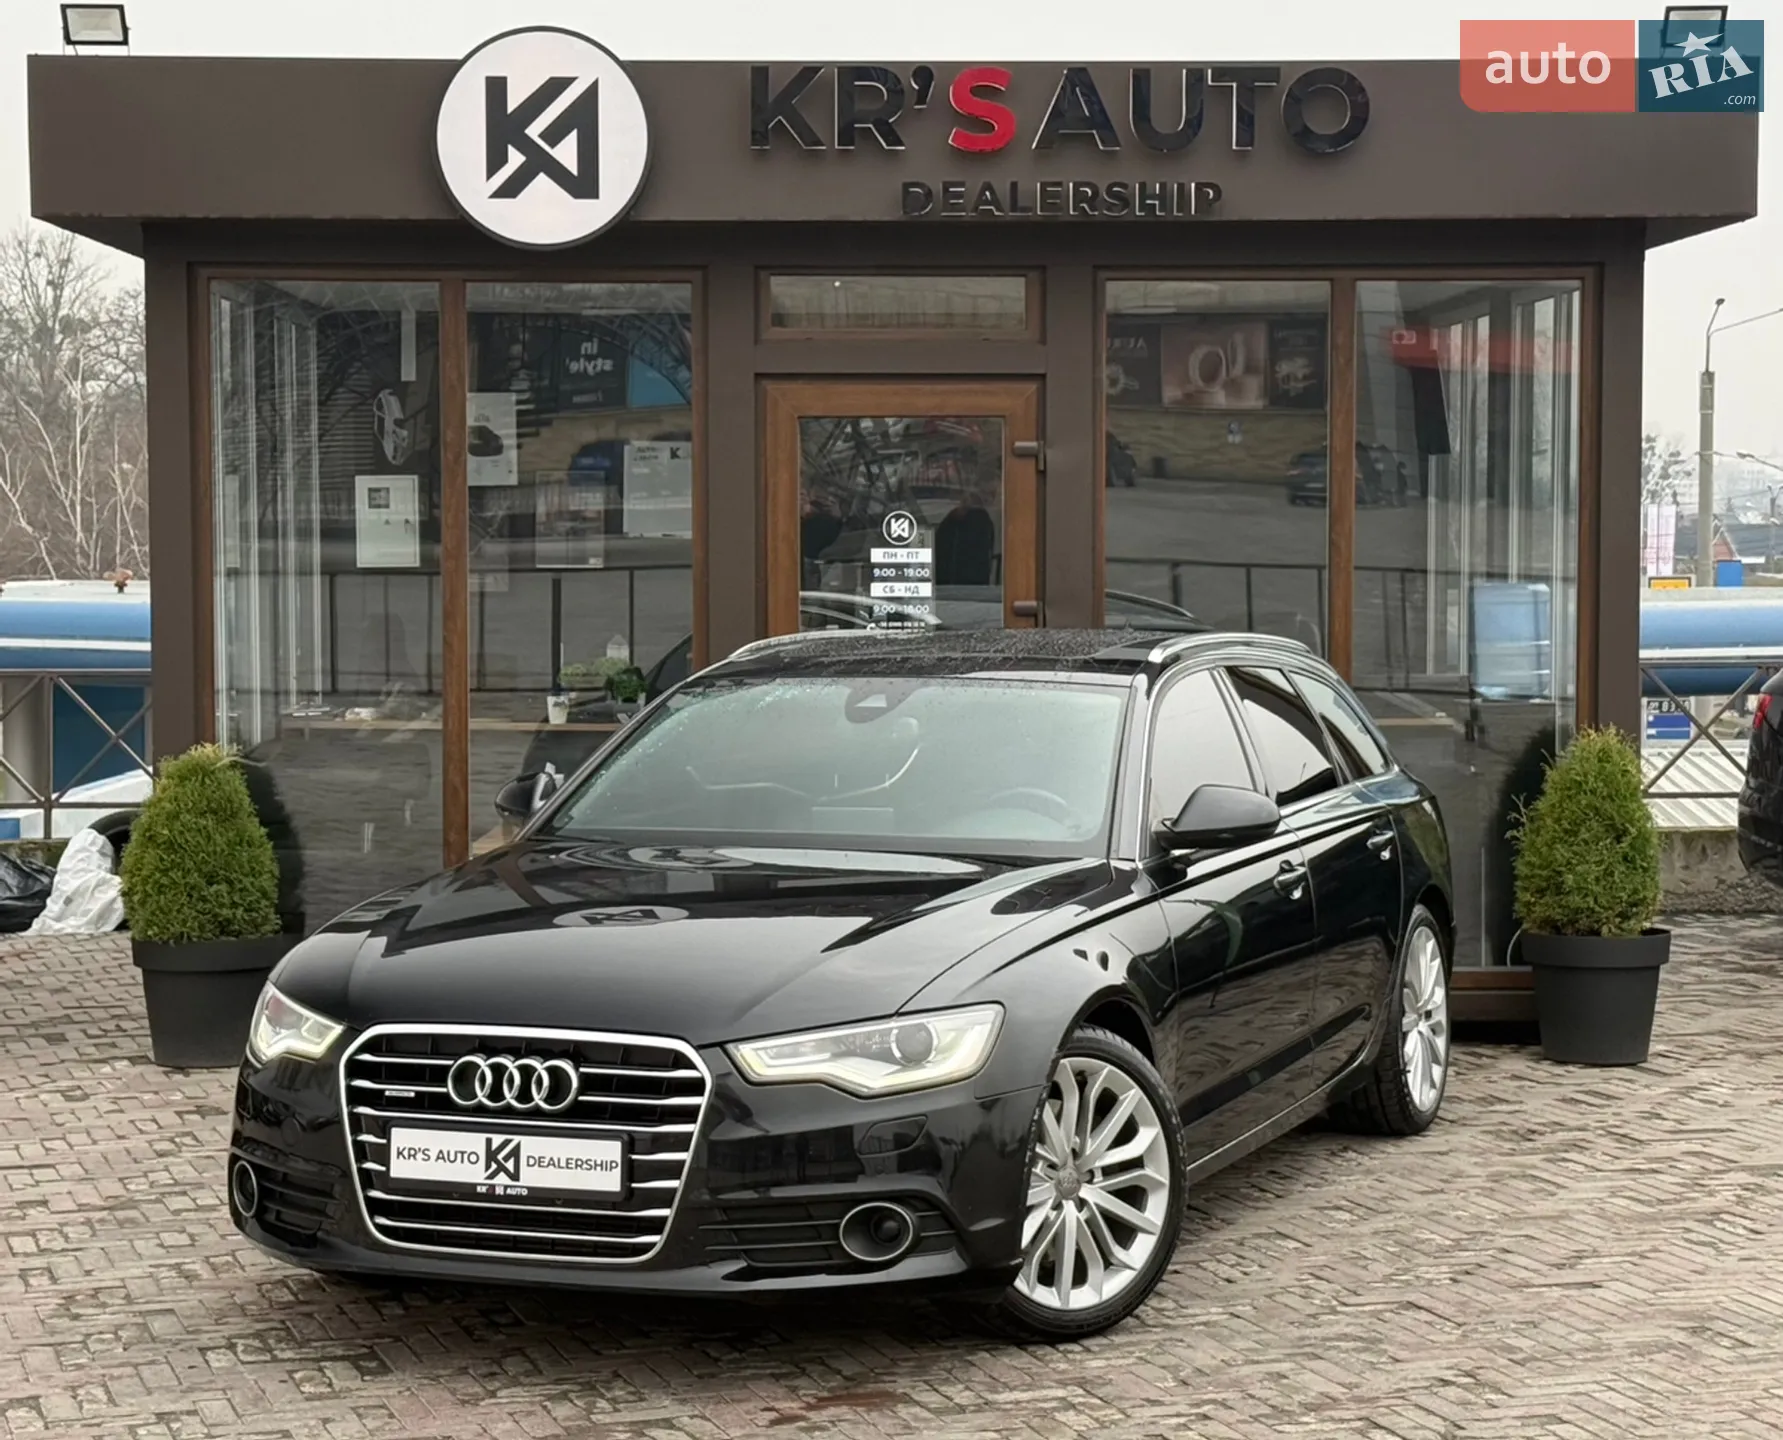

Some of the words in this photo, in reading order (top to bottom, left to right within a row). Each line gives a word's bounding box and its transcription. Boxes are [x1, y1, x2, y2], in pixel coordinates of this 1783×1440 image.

[749, 65, 1017, 152] KR'S
[1031, 66, 1370, 153] AUTO
[901, 180, 1223, 216] DEALERSHIP
[882, 551, 898, 560] ПН
[906, 551, 920, 560] ПТ
[396, 1146, 431, 1162] KR'S
[435, 1150, 480, 1165] AUTO
[526, 1155, 619, 1173] DEALERSHIP
